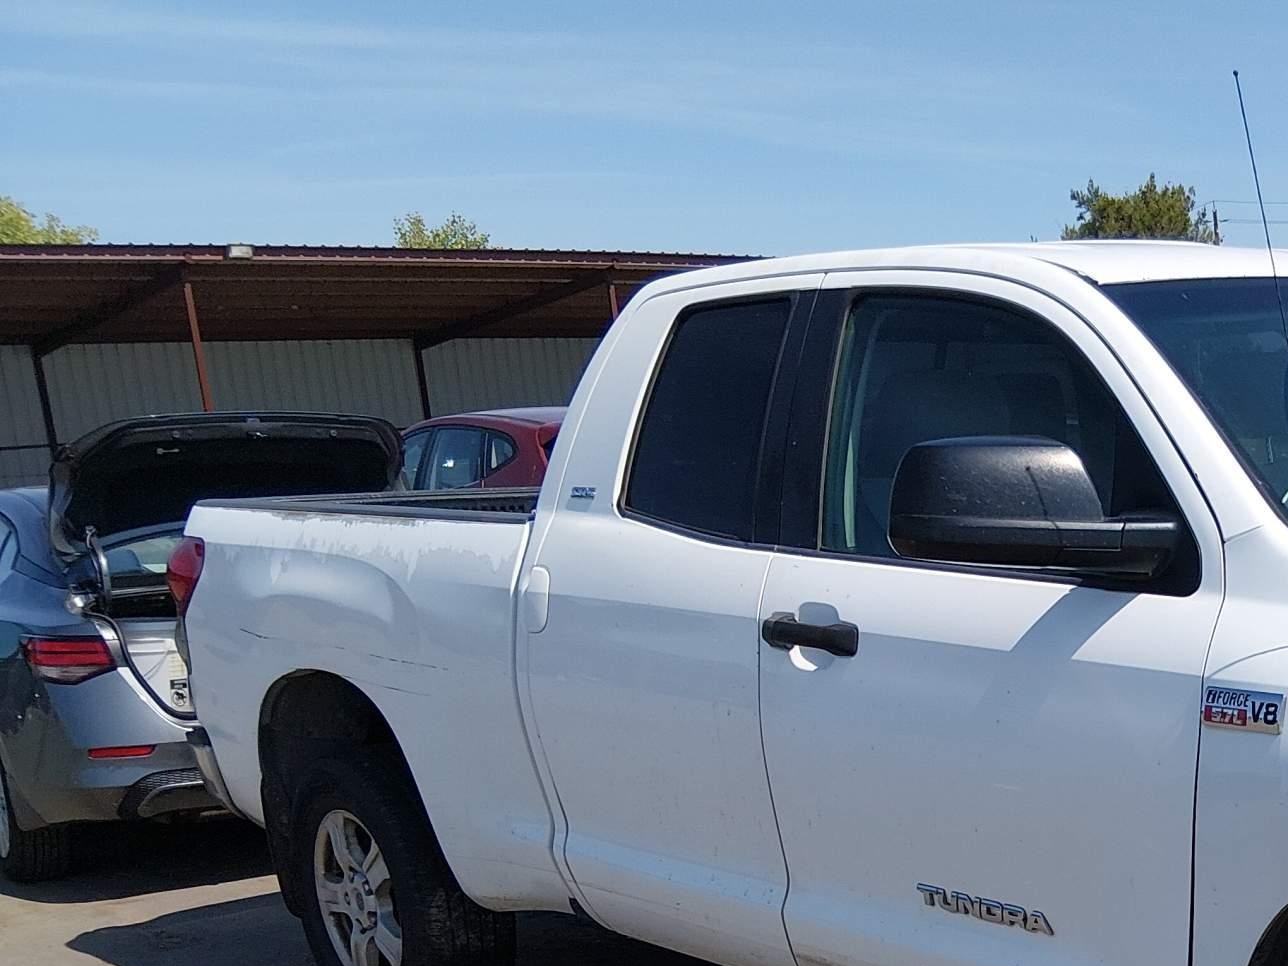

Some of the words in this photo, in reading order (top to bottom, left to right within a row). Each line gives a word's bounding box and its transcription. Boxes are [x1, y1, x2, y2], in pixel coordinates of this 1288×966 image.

[1210, 707, 1244, 725] 5.7L
[1251, 700, 1279, 725] V8
[916, 882, 1055, 936] TUNDRA
